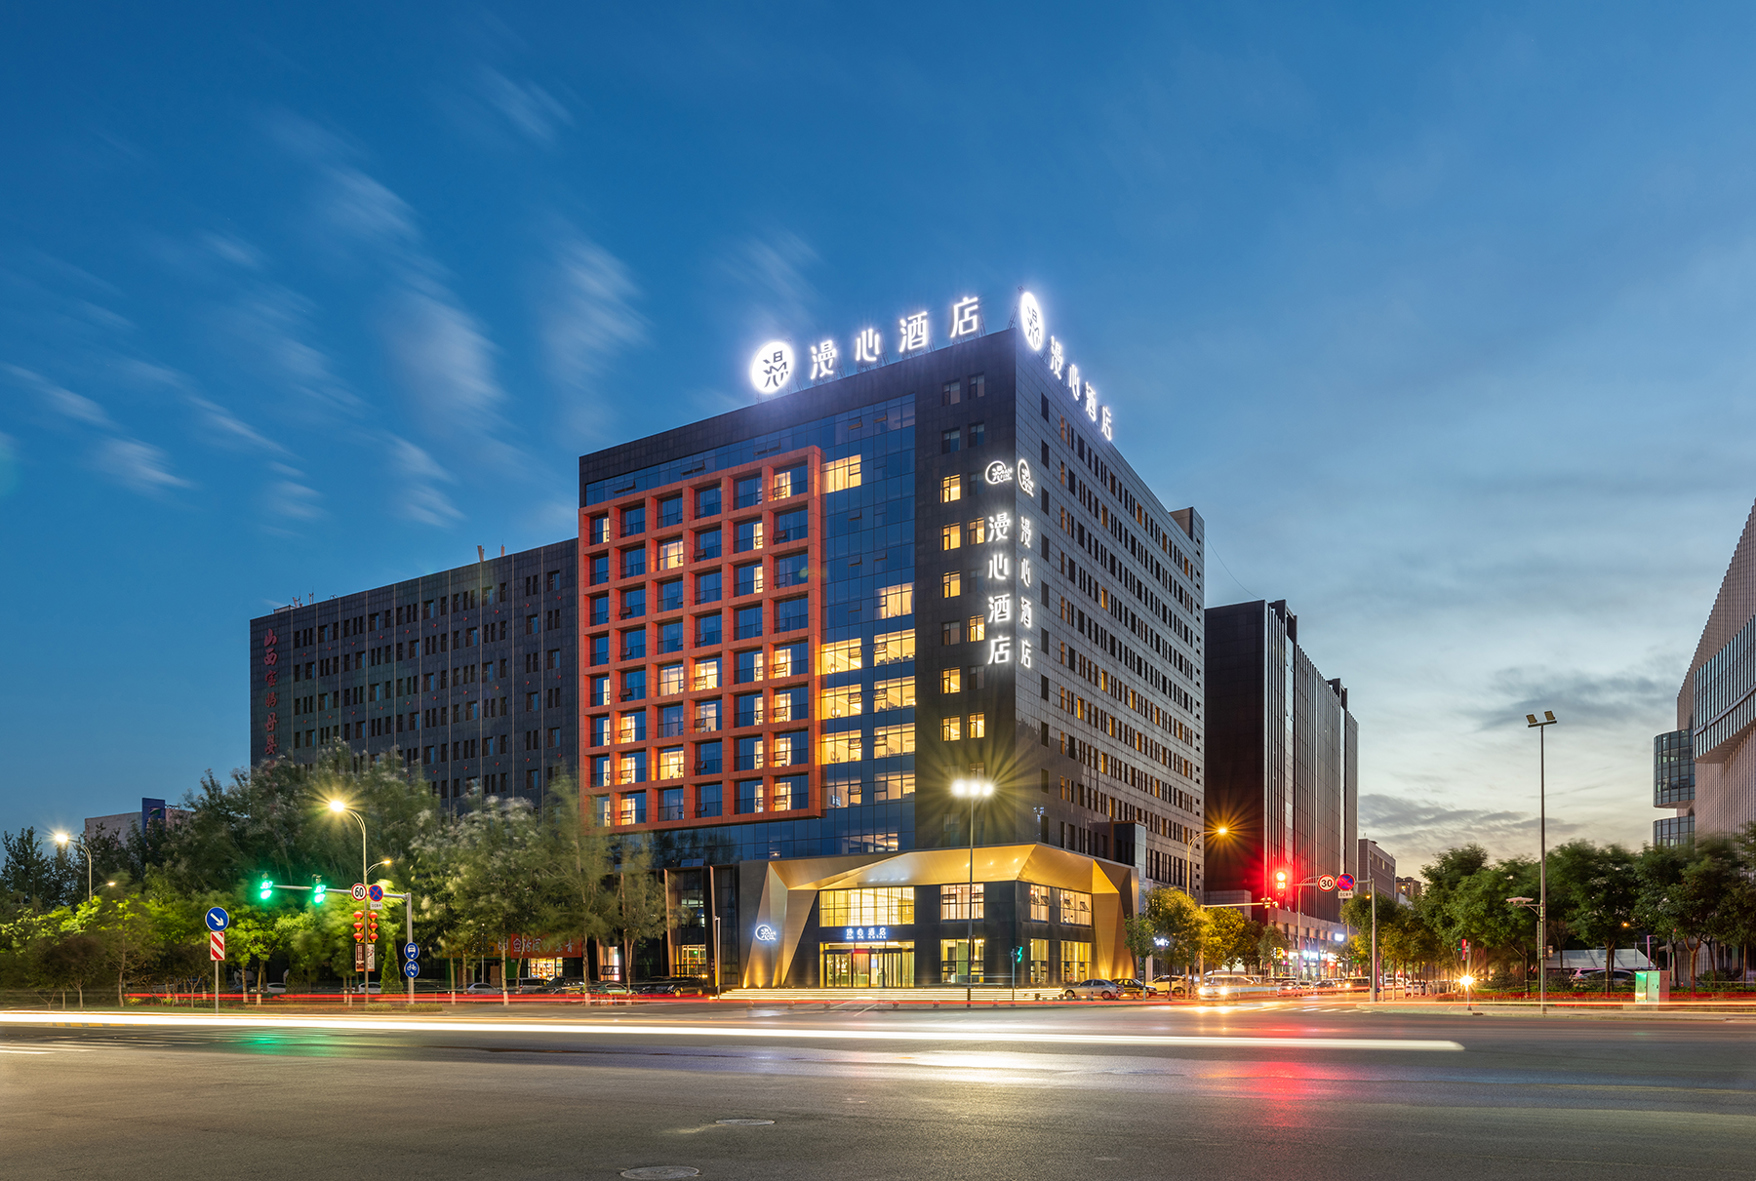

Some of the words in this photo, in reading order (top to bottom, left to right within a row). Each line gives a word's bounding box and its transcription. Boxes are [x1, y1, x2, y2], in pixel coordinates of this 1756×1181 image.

[810, 297, 979, 380] 漫心酒店
[1050, 336, 1113, 441] 漫心酒店
[988, 512, 1011, 665] 漫心酒店
[1020, 516, 1032, 669] 漫心酒店
[355, 887, 364, 897] 60
[1321, 879, 1333, 888] 30
